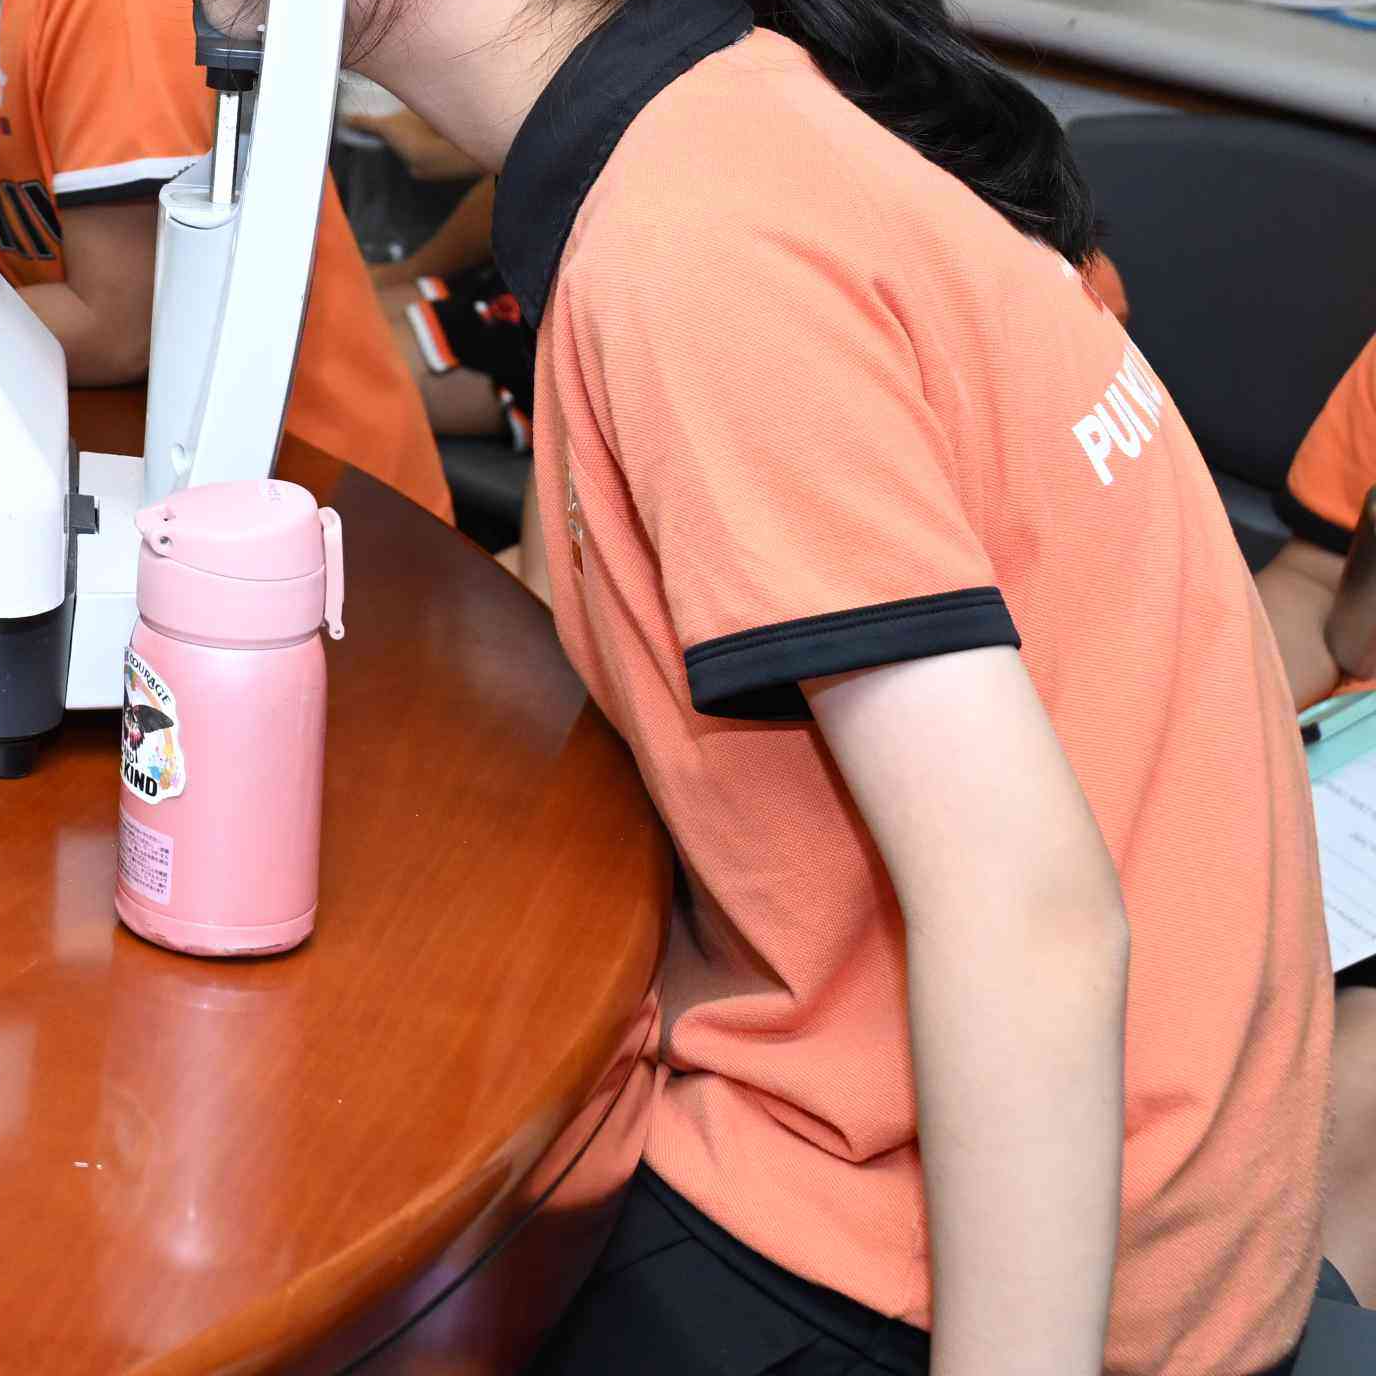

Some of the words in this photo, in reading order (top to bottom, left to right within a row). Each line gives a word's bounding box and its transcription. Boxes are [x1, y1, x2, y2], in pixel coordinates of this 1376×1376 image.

[1071, 383, 1153, 486] PUI
[129, 653, 172, 706] COURAGE
[123, 760, 158, 798] KIND
